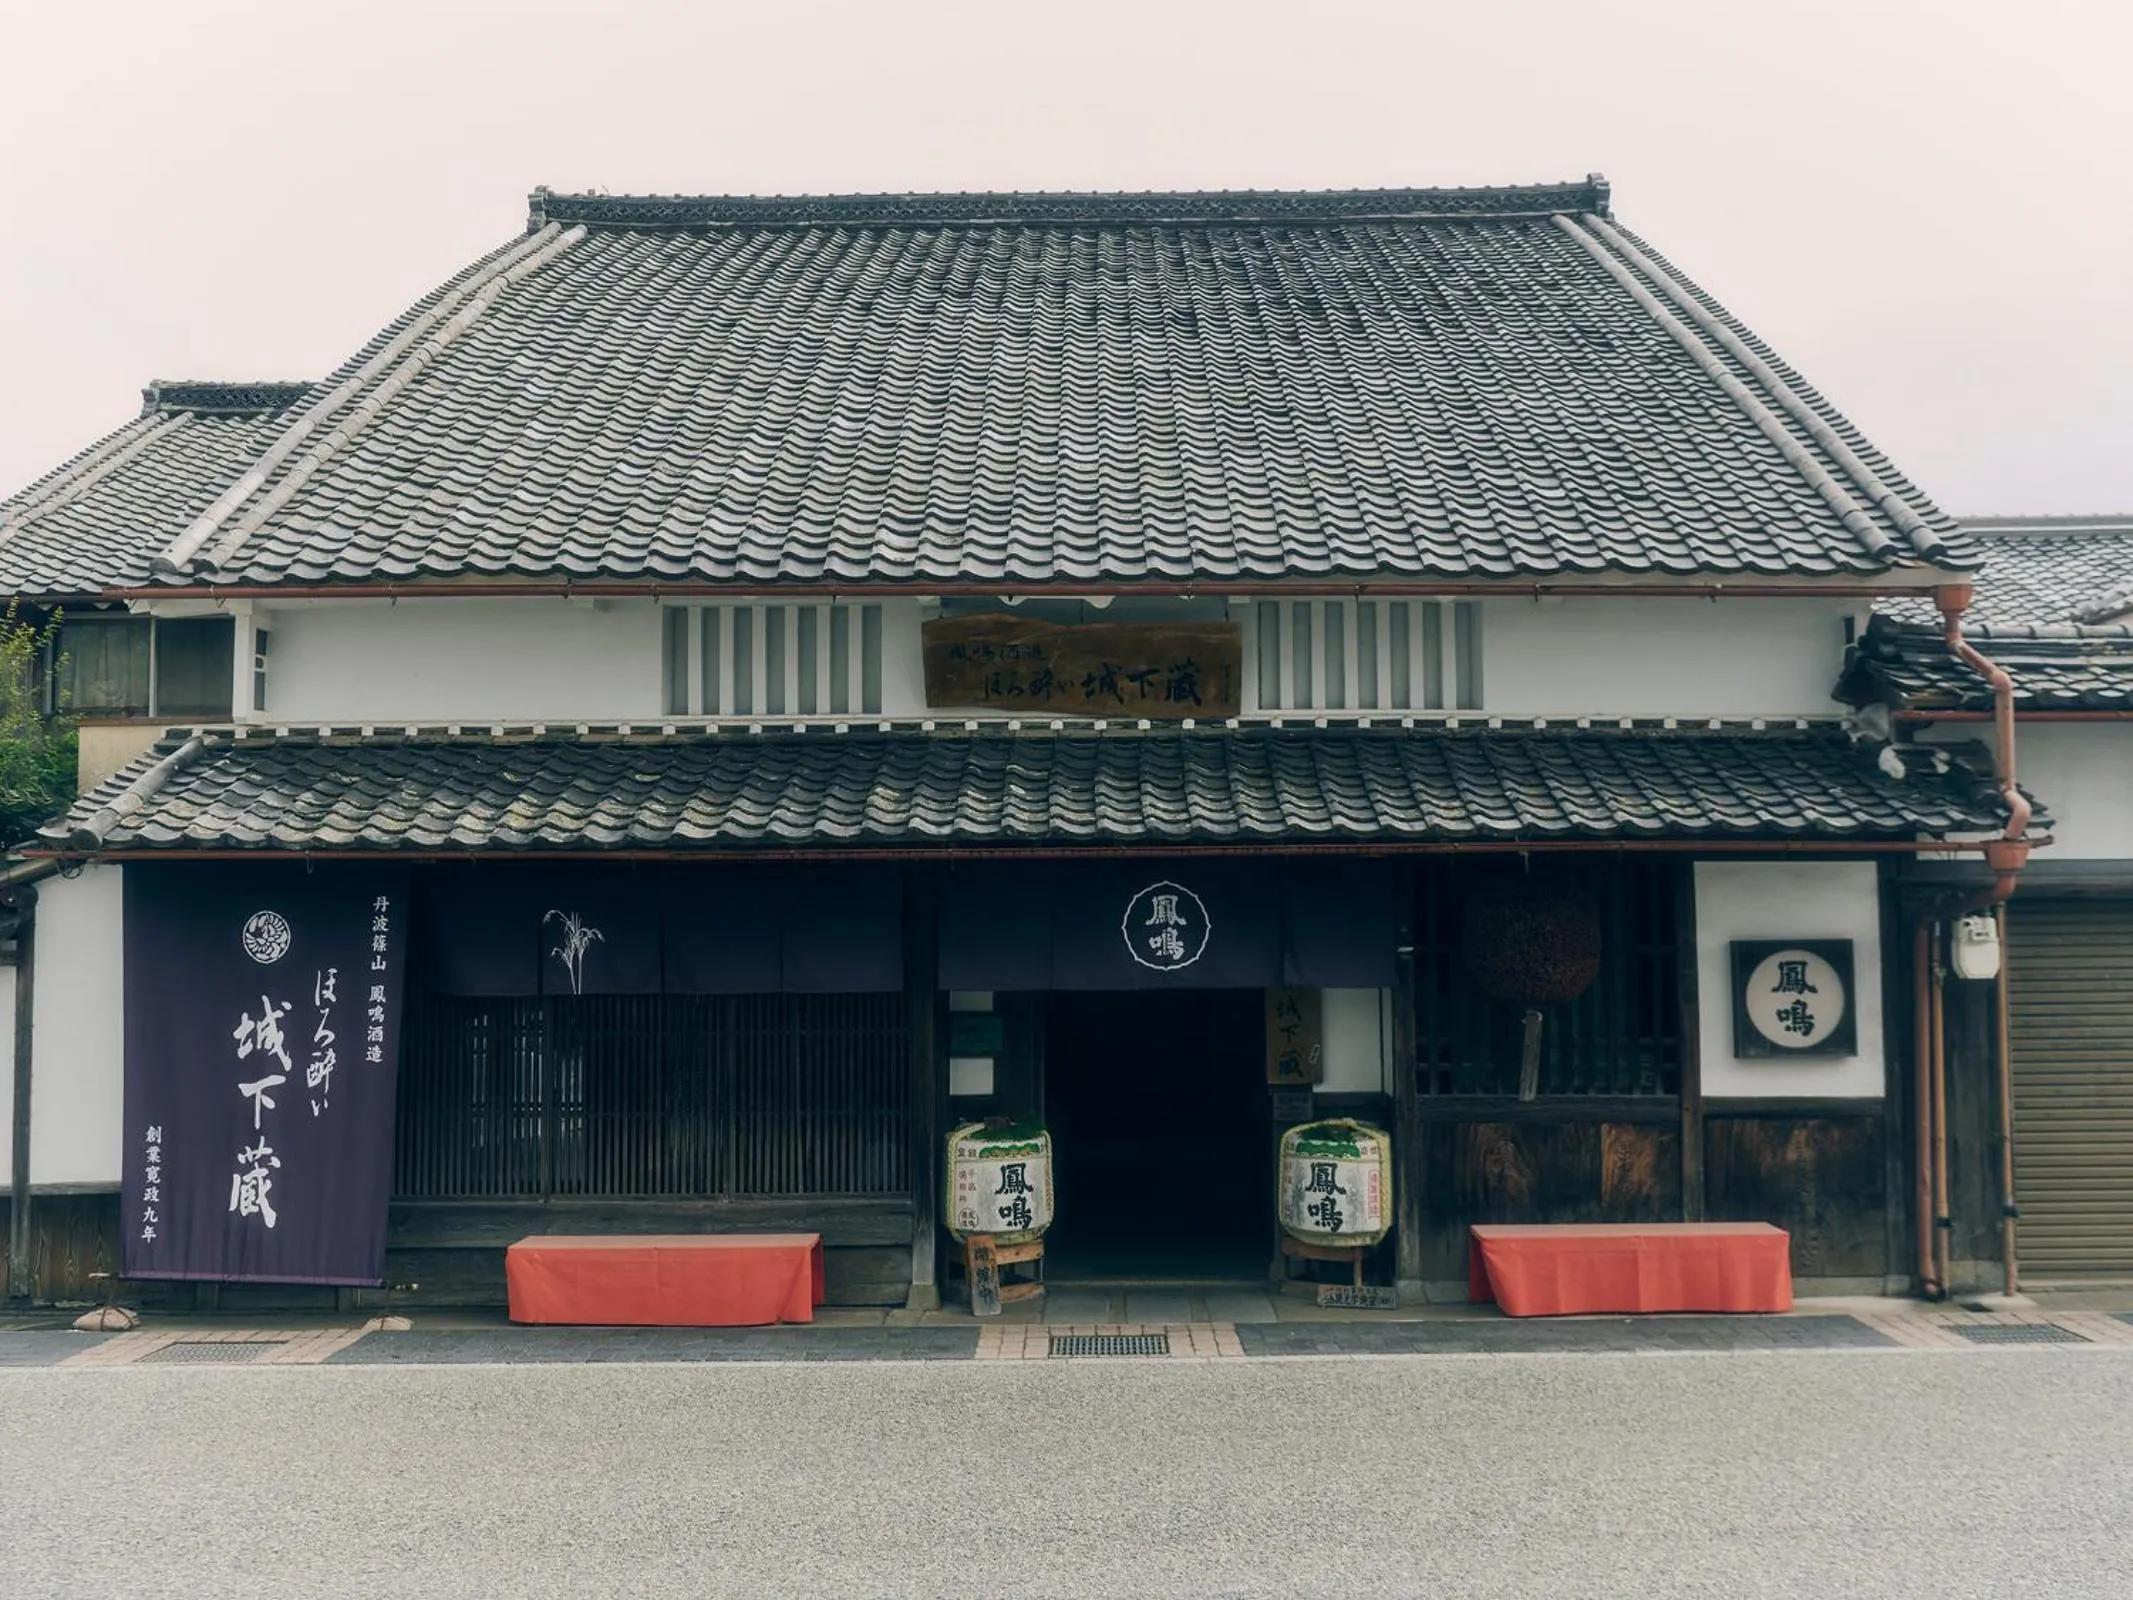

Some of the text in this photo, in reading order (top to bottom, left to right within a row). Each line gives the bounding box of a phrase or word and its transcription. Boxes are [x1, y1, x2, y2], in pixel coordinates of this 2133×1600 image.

[1145, 894, 1187, 960] 鳳鳴
[365, 896, 390, 1063] 丹波篠山 鳳鳴酒造
[1771, 959, 1818, 1037] 鳳鳴
[306, 968, 338, 1117] ほろ酔い
[228, 995, 293, 1229] 城下蔵
[141, 1125, 162, 1243] 創業寛政九年
[994, 1162, 1034, 1229] 鳳鳴
[1305, 1162, 1346, 1232] 鳳鳴
